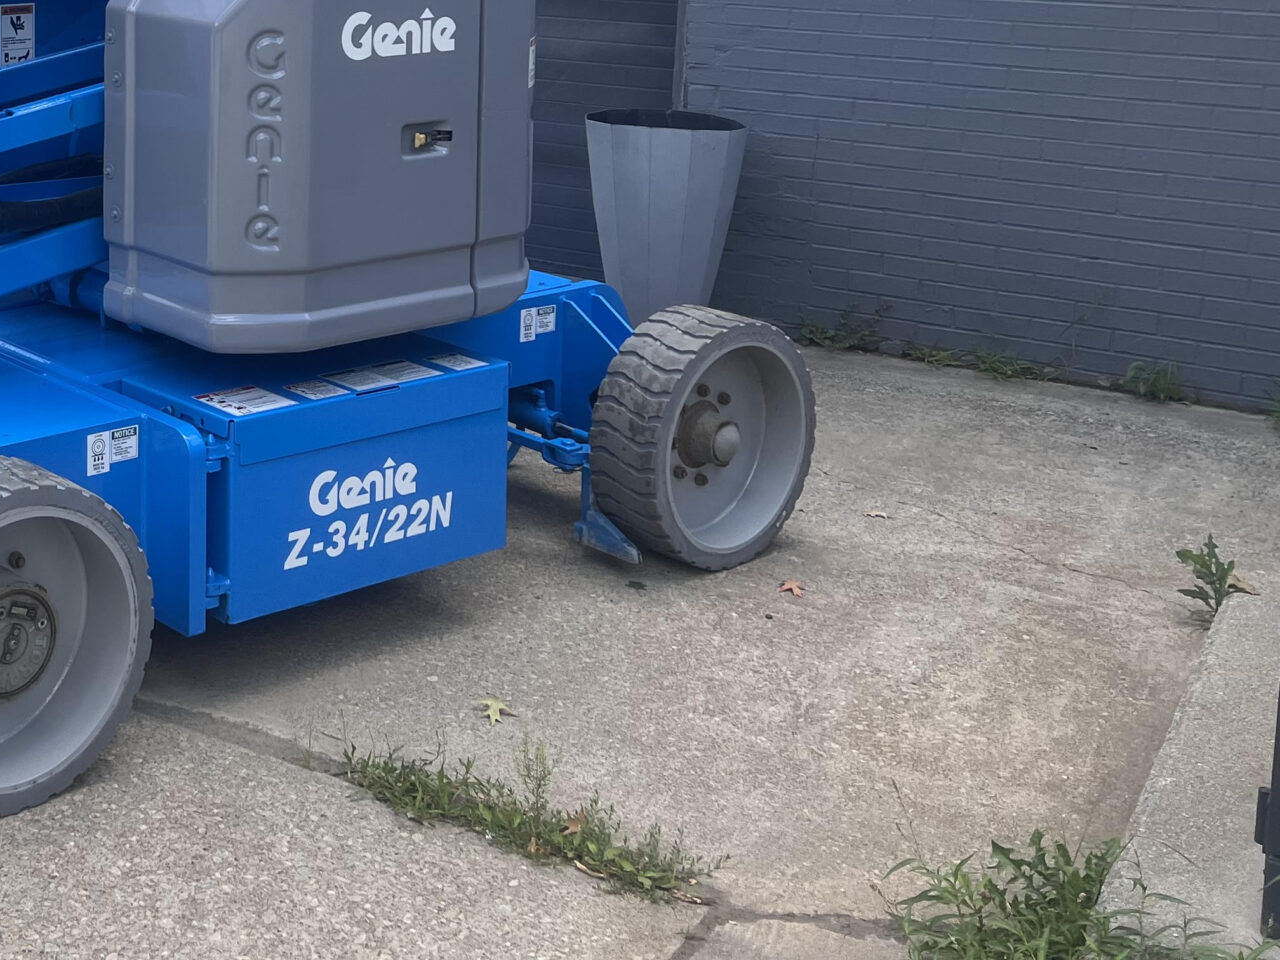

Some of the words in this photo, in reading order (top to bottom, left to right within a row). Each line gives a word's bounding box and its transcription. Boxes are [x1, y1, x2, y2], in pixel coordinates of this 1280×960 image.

[341, 7, 457, 61] Genie
[246, 28, 286, 252] Genie
[113, 427, 136, 439] NOTICE
[308, 456, 418, 516] Genie
[283, 490, 453, 571] Z-34/22N
